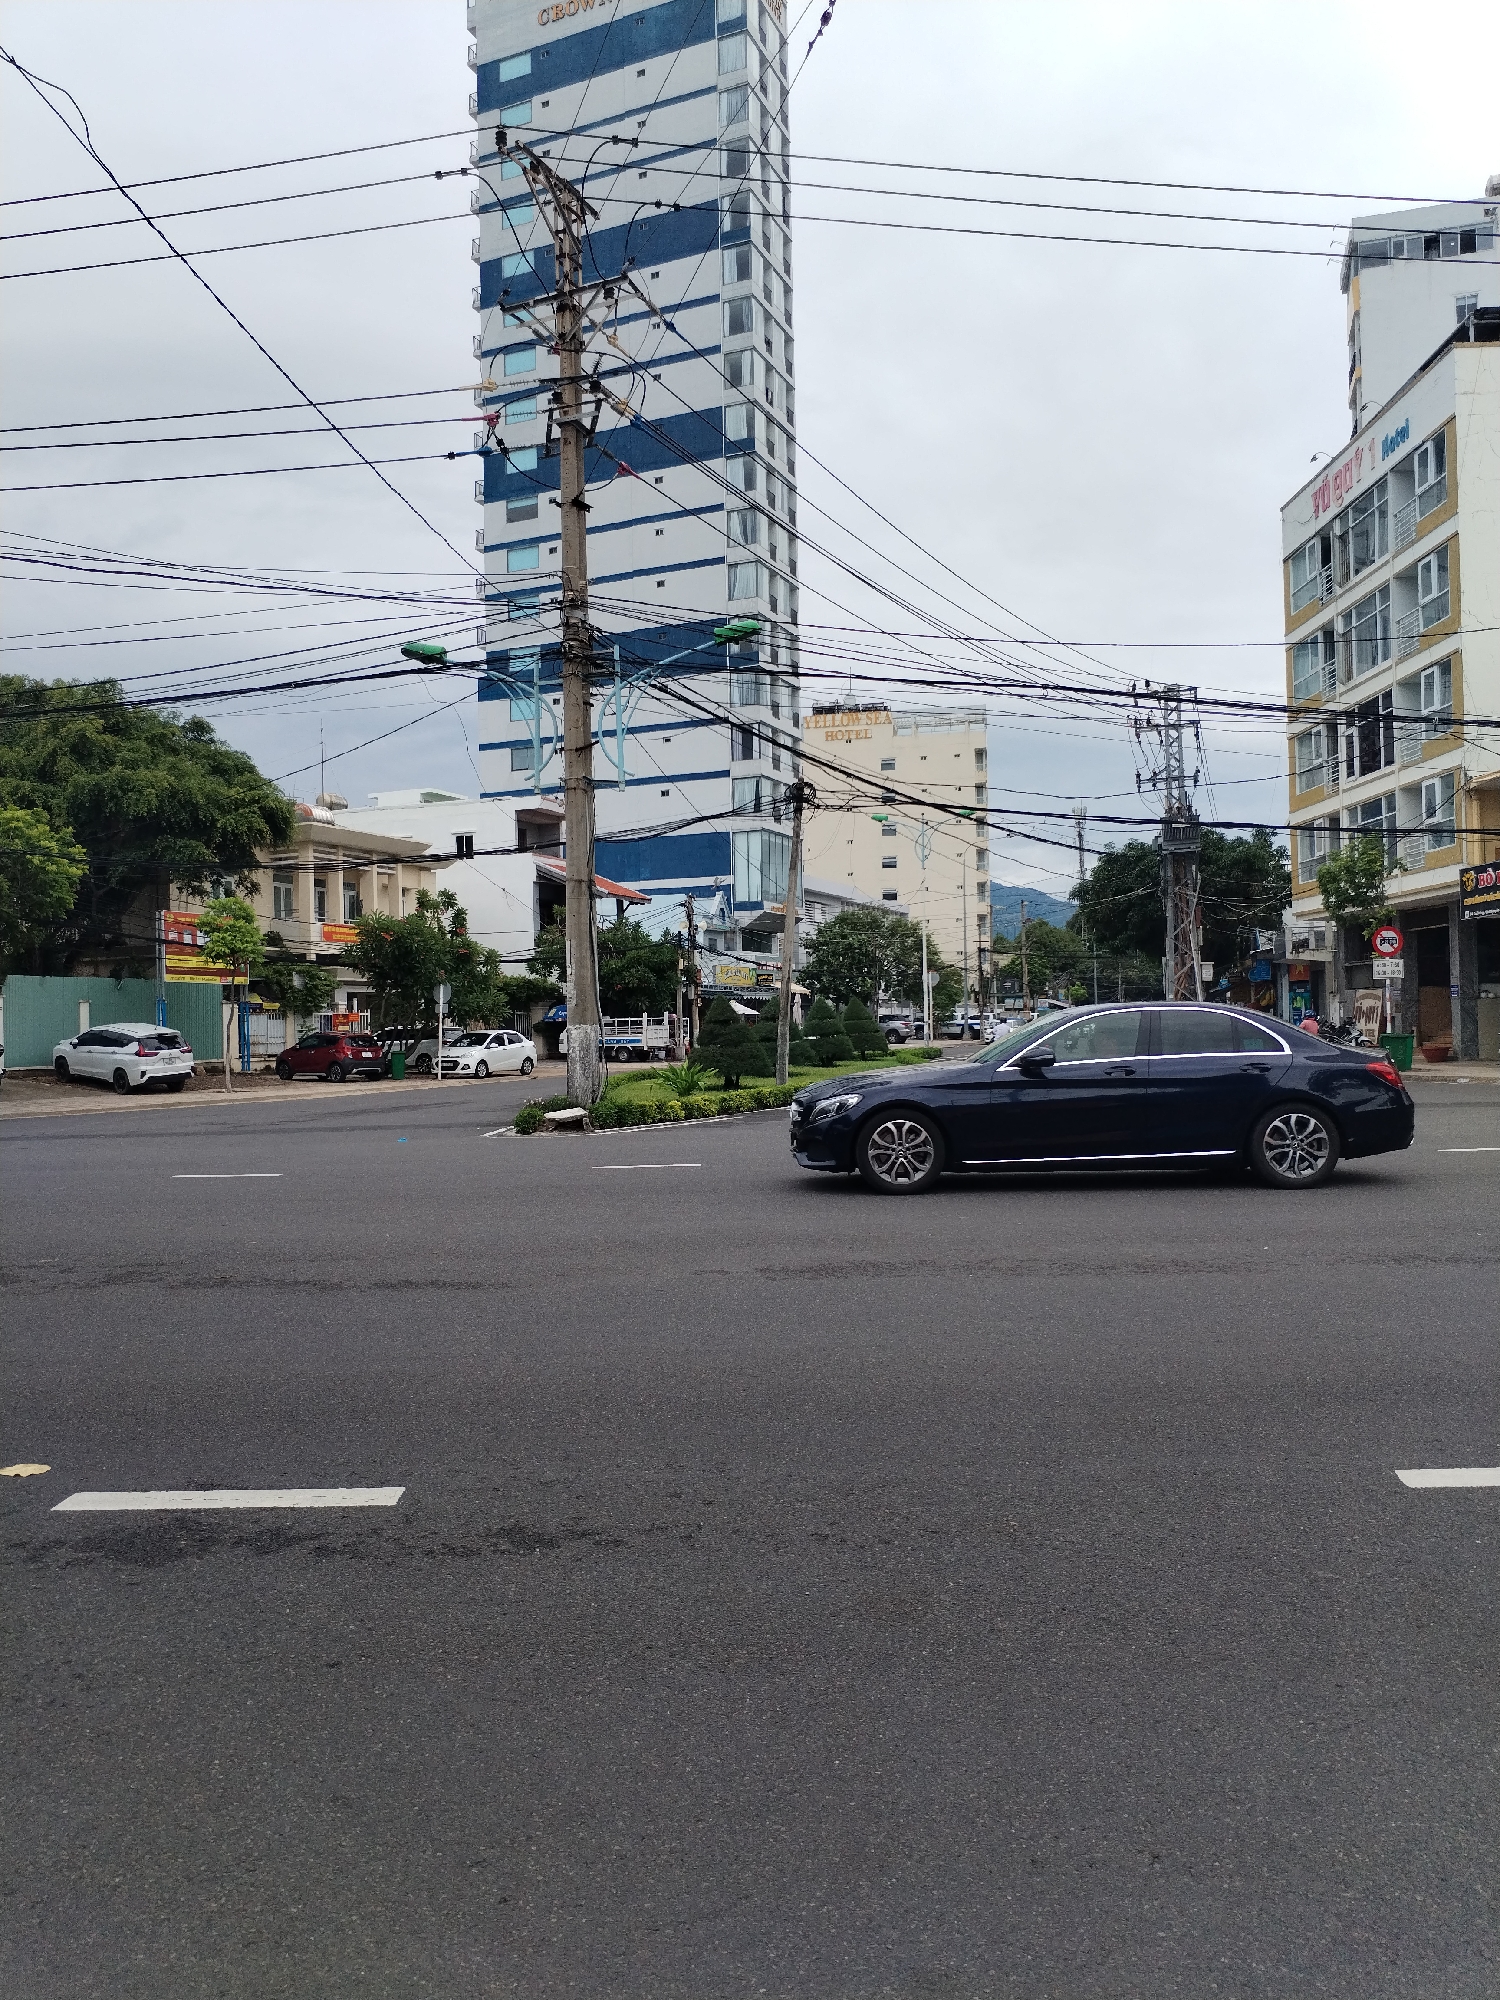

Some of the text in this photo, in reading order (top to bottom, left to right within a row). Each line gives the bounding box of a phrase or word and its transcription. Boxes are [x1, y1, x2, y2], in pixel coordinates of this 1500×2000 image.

[538, 0, 613, 26] CROW
[1381, 418, 1410, 461] Hotel
[803, 711, 892, 729] YELLOW SEA
[825, 729, 872, 741] HOTEL
